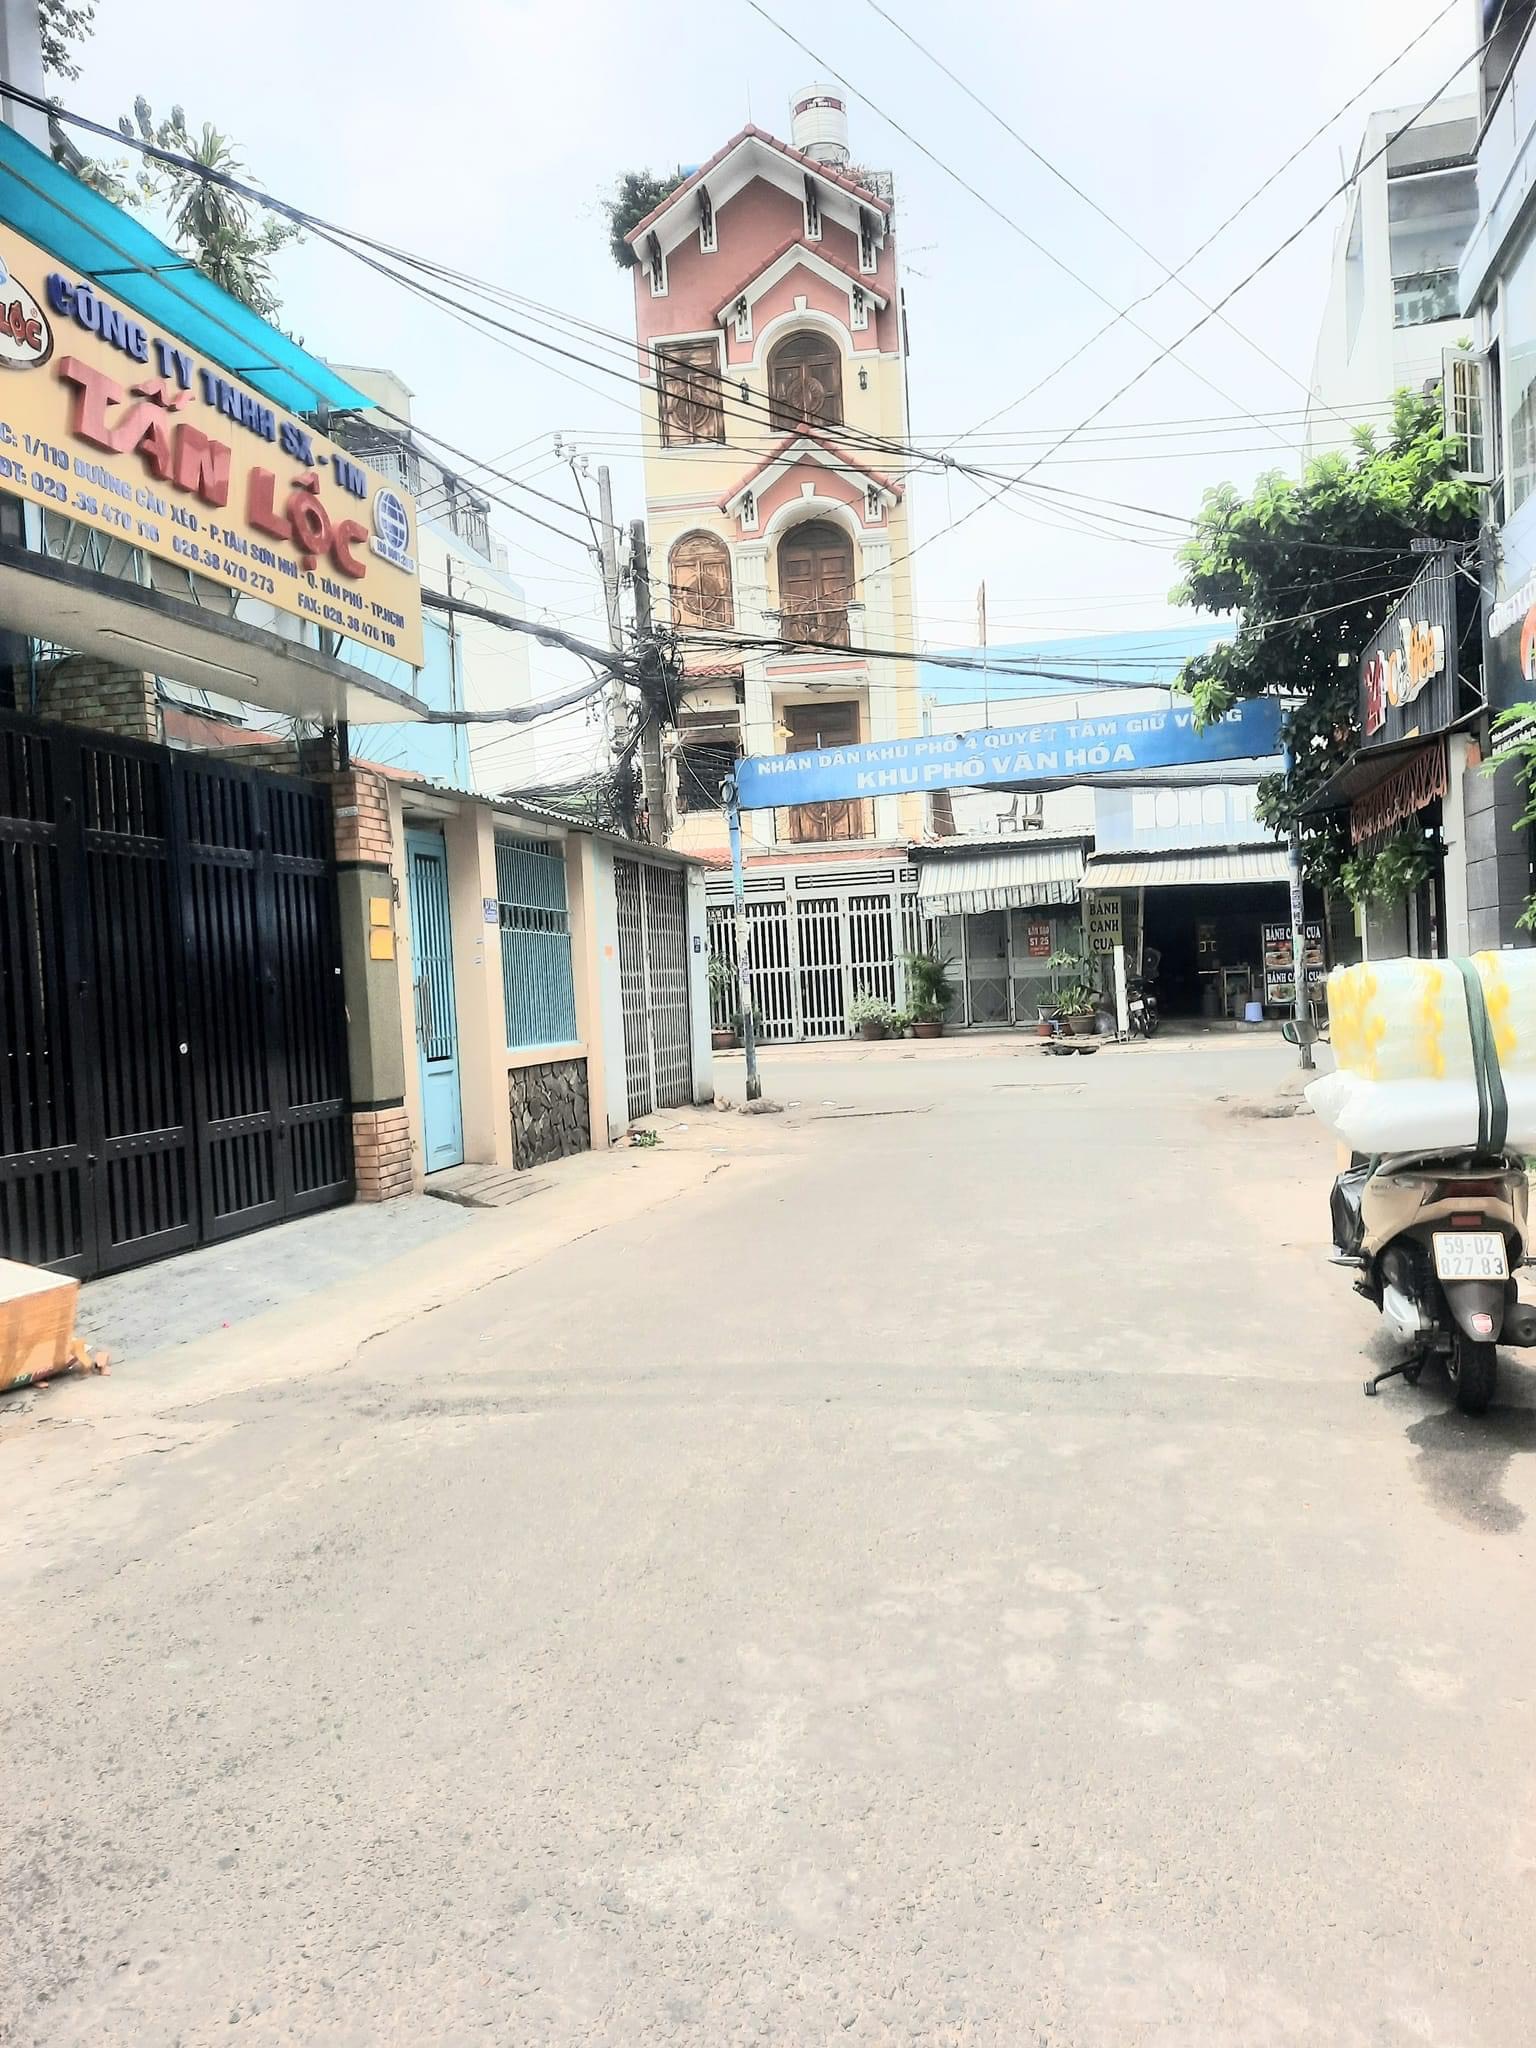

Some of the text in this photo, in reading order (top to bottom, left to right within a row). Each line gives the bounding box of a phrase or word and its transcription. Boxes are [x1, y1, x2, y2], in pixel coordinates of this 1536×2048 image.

[47, 272, 148, 363] CÔNG
[153, 338, 194, 390] TY
[200, 368, 276, 442] TNHH
[281, 421, 314, 466] SX
[332, 454, 367, 499] TM
[23, 434, 69, 470] 1/119
[31, 472, 67, 502] 028
[102, 503, 132, 530] 470
[223, 559, 247, 582] 470
[250, 571, 274, 594] 273
[298, 592, 321, 615] FAX:
[249, 467, 368, 578] LỘC
[819, 751, 860, 768] DÂN
[866, 745, 908, 761] KHU
[965, 737, 977, 749] 4
[1066, 719, 1117, 739] TÂM
[857, 740, 1136, 789] KHU PHỐ VĂN HÓA
[1089, 920, 1119, 933] CANH
[1306, 926, 1321, 938] CUA
